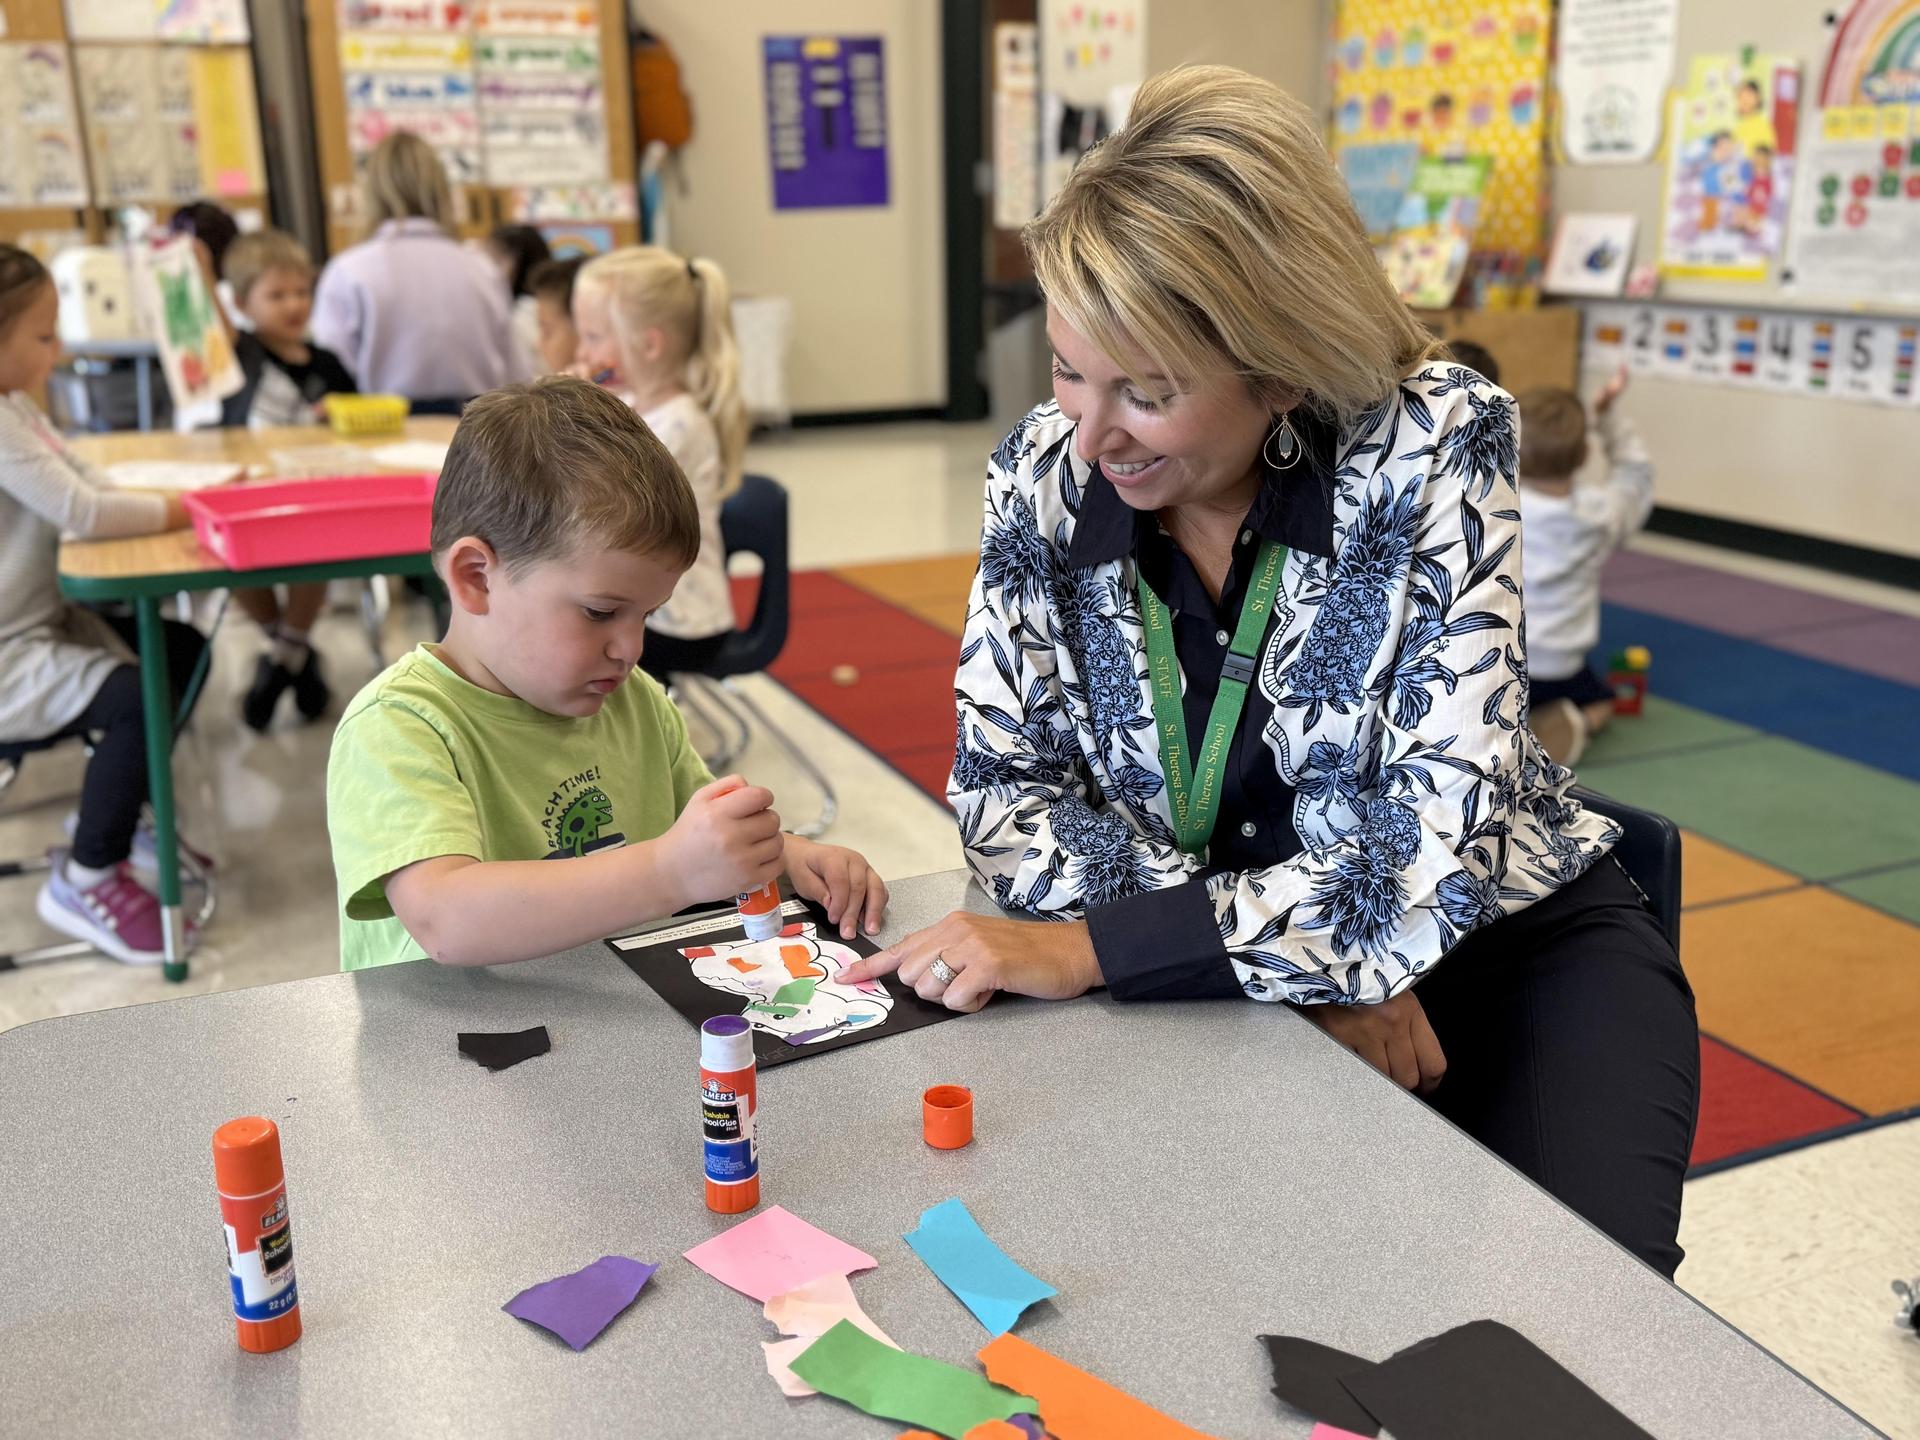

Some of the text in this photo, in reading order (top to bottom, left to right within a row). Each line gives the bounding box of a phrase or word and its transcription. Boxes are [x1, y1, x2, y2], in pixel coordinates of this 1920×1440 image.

[1634, 310, 1652, 348] 2
[1701, 315, 1719, 354] 3
[1769, 323, 1792, 360] 4
[1851, 327, 1873, 370] 5
[1252, 545, 1280, 613] St. Theresa
[1156, 656, 1172, 697] STAFF
[1165, 724, 1177, 740] St.
[559, 765, 601, 793] TIME!
[1168, 743, 1183, 789] Theresa
[1194, 723, 1227, 830] St. Theresa School
[269, 1301, 280, 1311] 22
